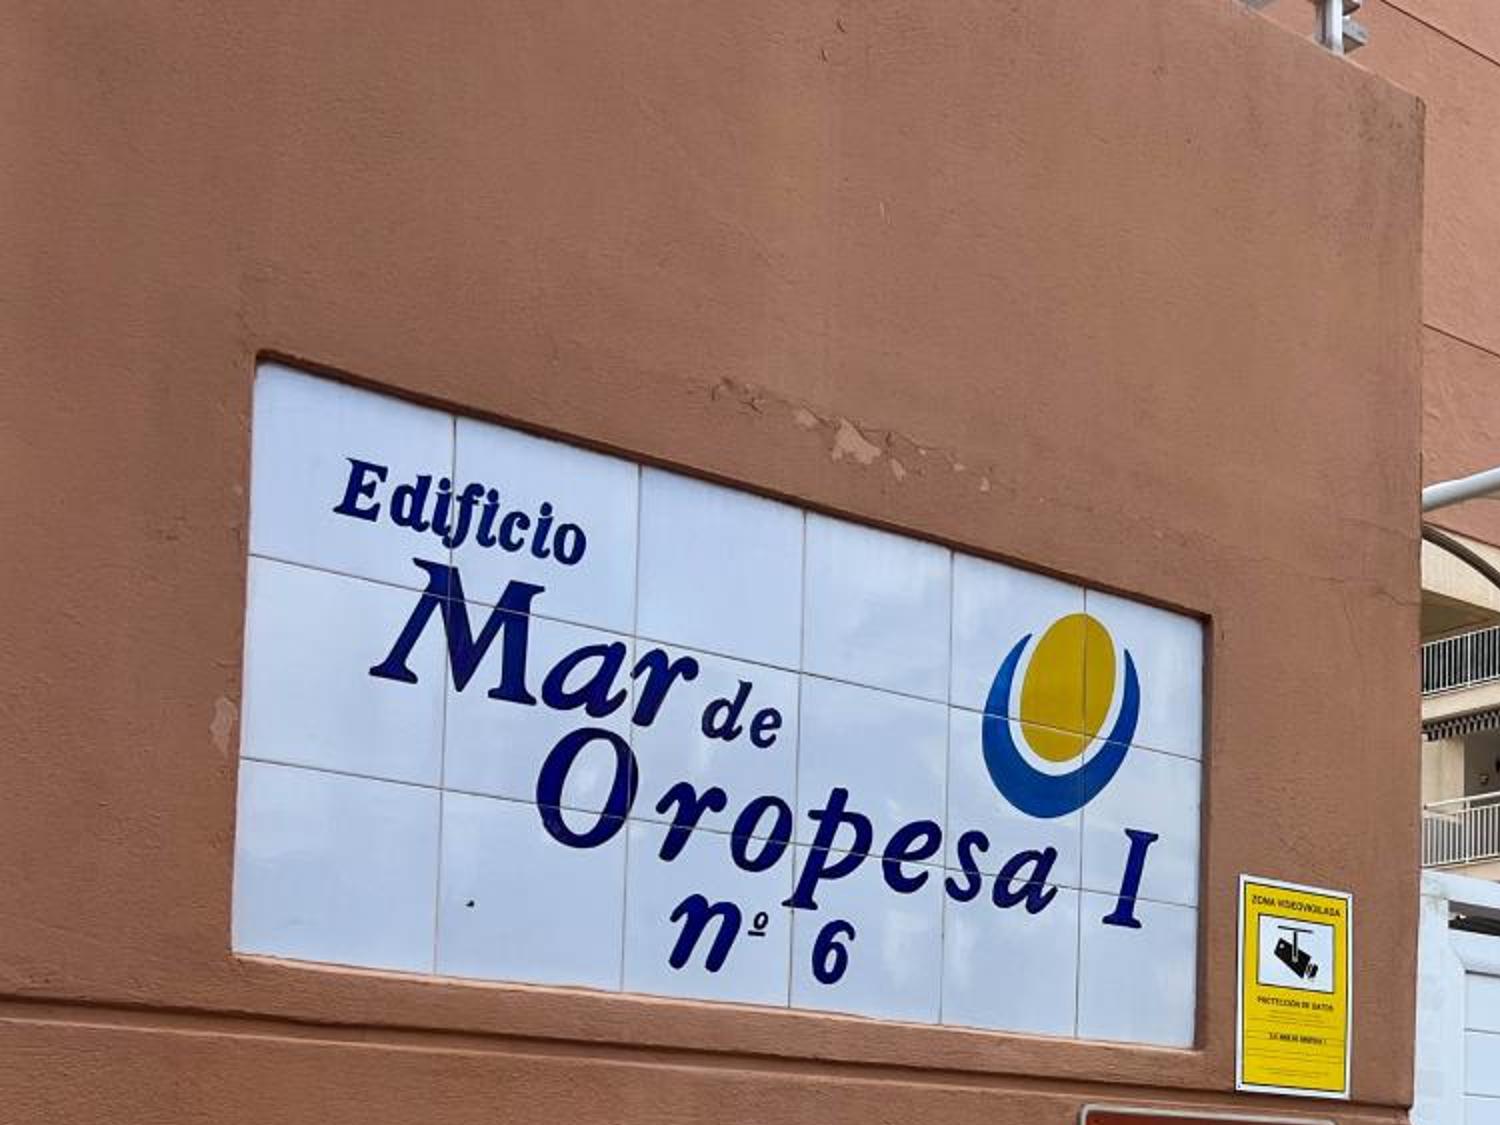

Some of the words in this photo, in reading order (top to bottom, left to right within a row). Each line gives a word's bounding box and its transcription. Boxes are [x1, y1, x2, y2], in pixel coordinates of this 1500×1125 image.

[332, 457, 587, 566] Edificio
[368, 557, 699, 728] Mar
[701, 679, 783, 749] de
[535, 727, 1059, 915] Oropesa
[1101, 828, 1159, 929] I
[811, 919, 856, 985] 6
[1252, 895, 1275, 906] ZONA
